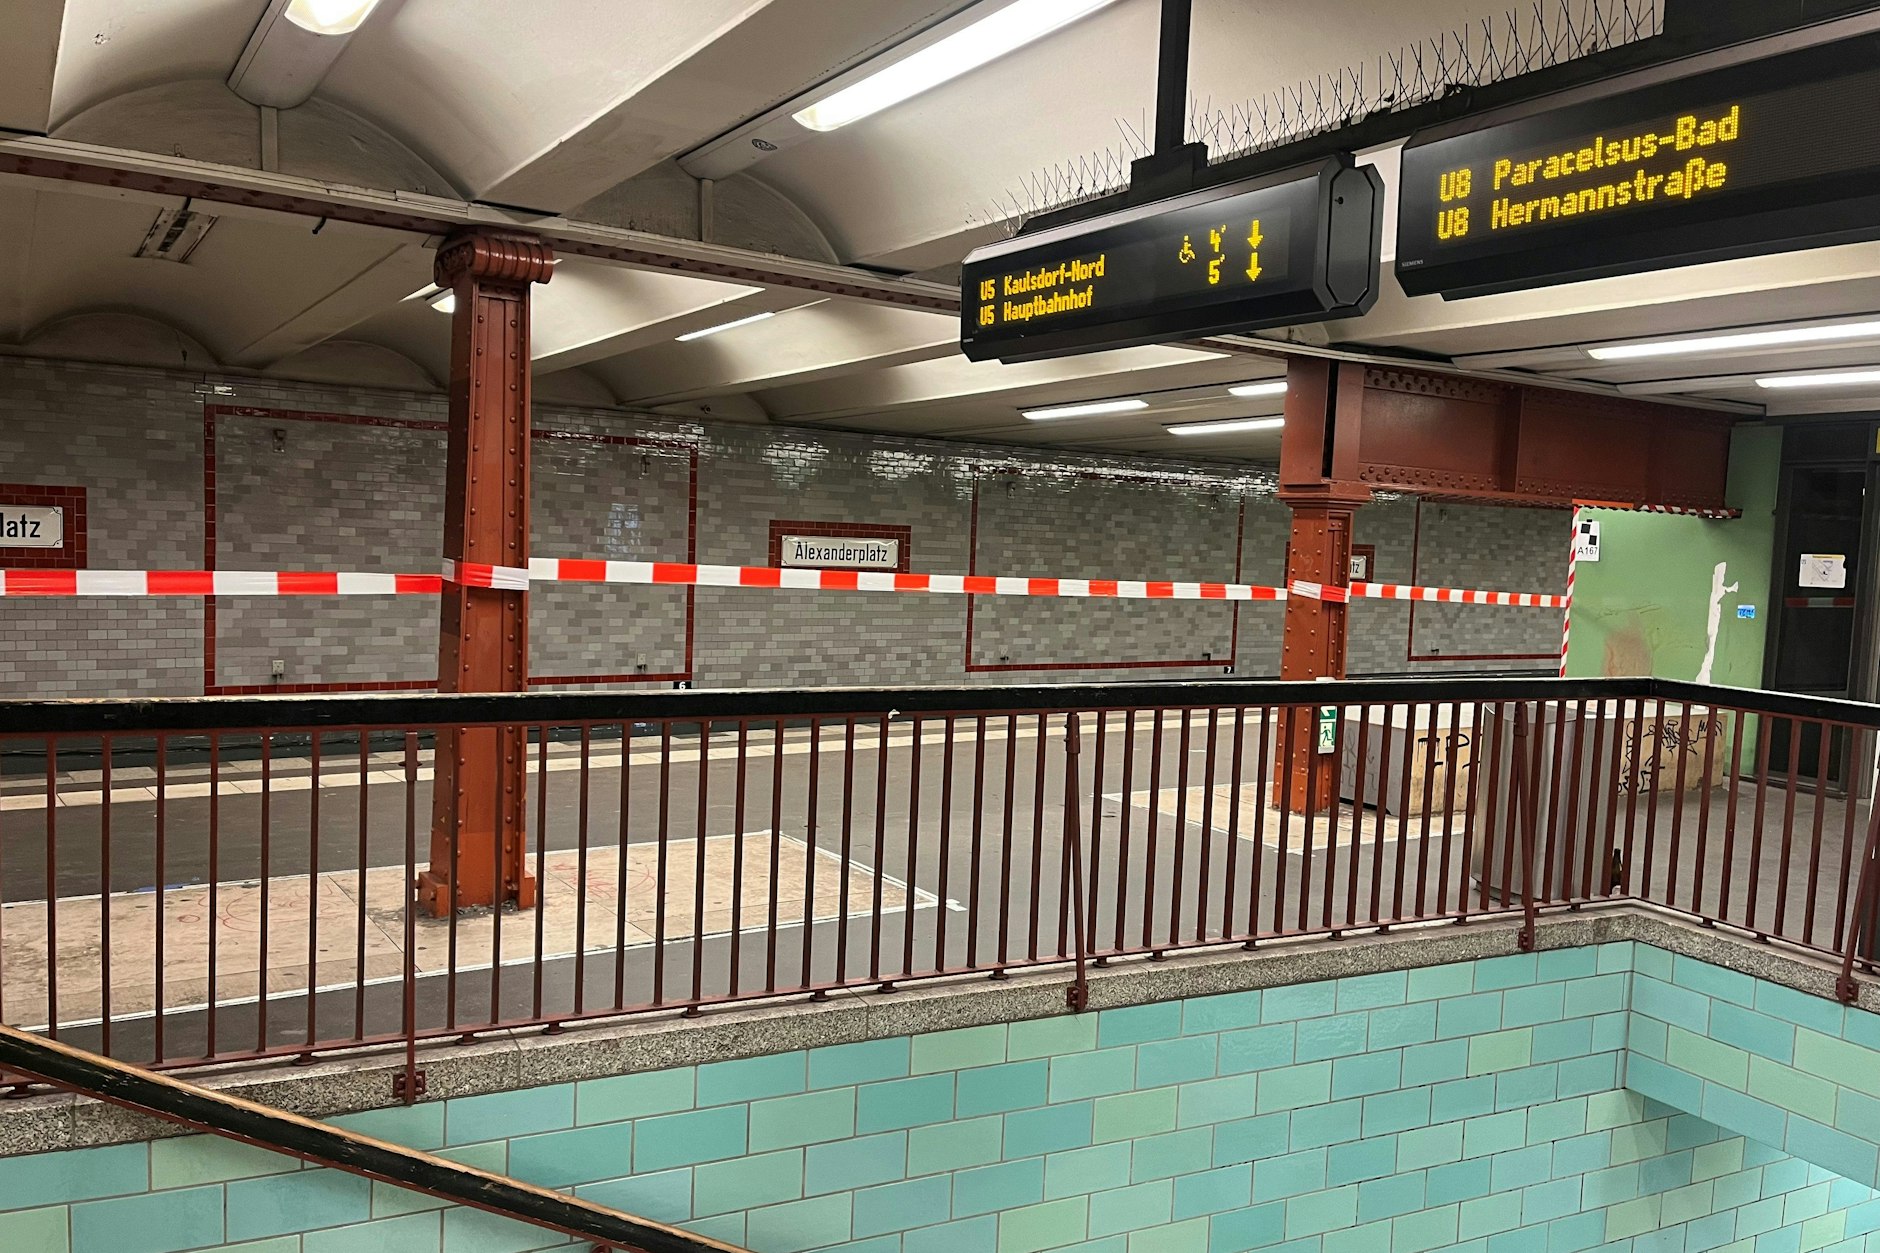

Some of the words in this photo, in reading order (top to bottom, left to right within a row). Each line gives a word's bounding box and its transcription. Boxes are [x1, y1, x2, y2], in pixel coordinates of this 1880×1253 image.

[1440, 167, 1472, 203] U8
[1492, 104, 1740, 190] Paracelsus-Bad
[1437, 207, 1469, 240] U8
[1491, 157, 1728, 231] Hermannstraße
[980, 279, 996, 301] U5
[1004, 254, 1105, 296] Kaulsdorf-Nord
[980, 304, 995, 326] U5
[1003, 284, 1094, 322] Hauptbahnhof
[794, 541, 888, 564] Alexanderplatz
[679, 681, 686, 690] 6
[1227, 666, 1232, 674] 7
